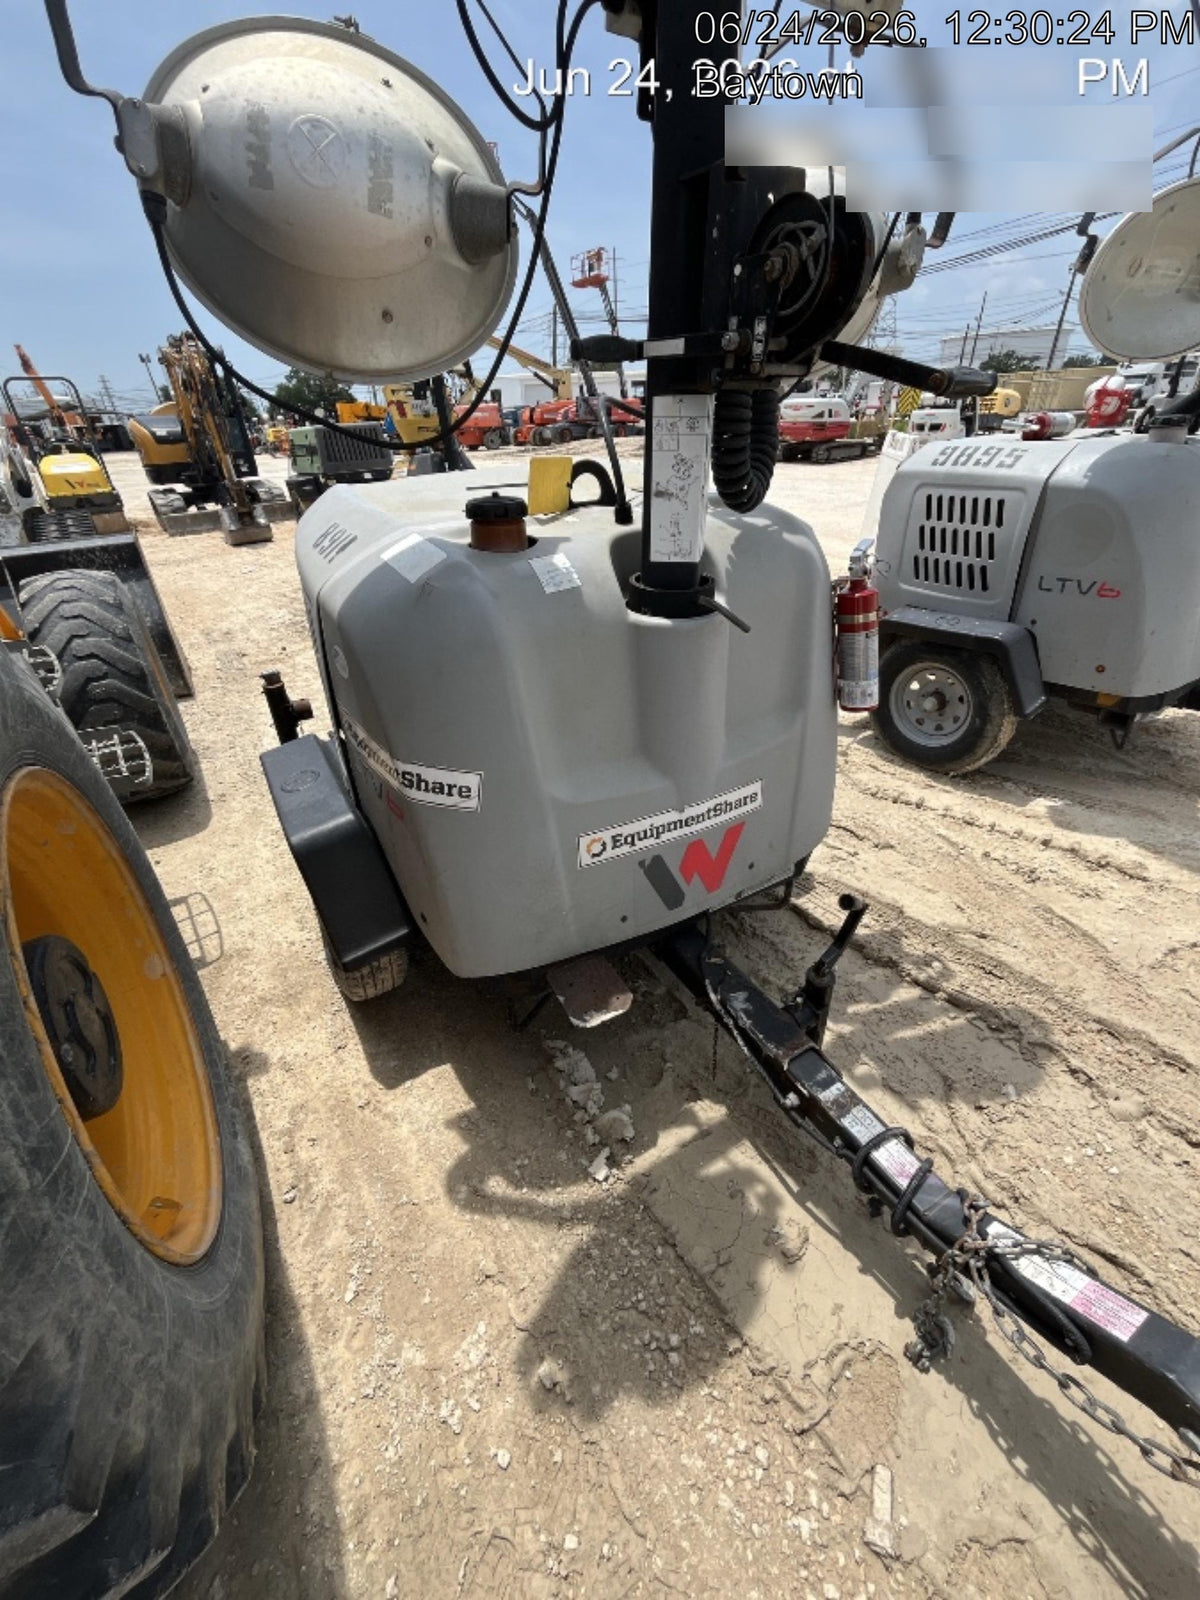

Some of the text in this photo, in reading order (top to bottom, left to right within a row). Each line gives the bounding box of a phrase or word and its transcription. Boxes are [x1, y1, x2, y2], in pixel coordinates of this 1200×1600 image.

[931, 445, 1029, 468] 9895
[1038, 575, 1122, 599] LTV6
[611, 789, 758, 851] EquipmentShare
